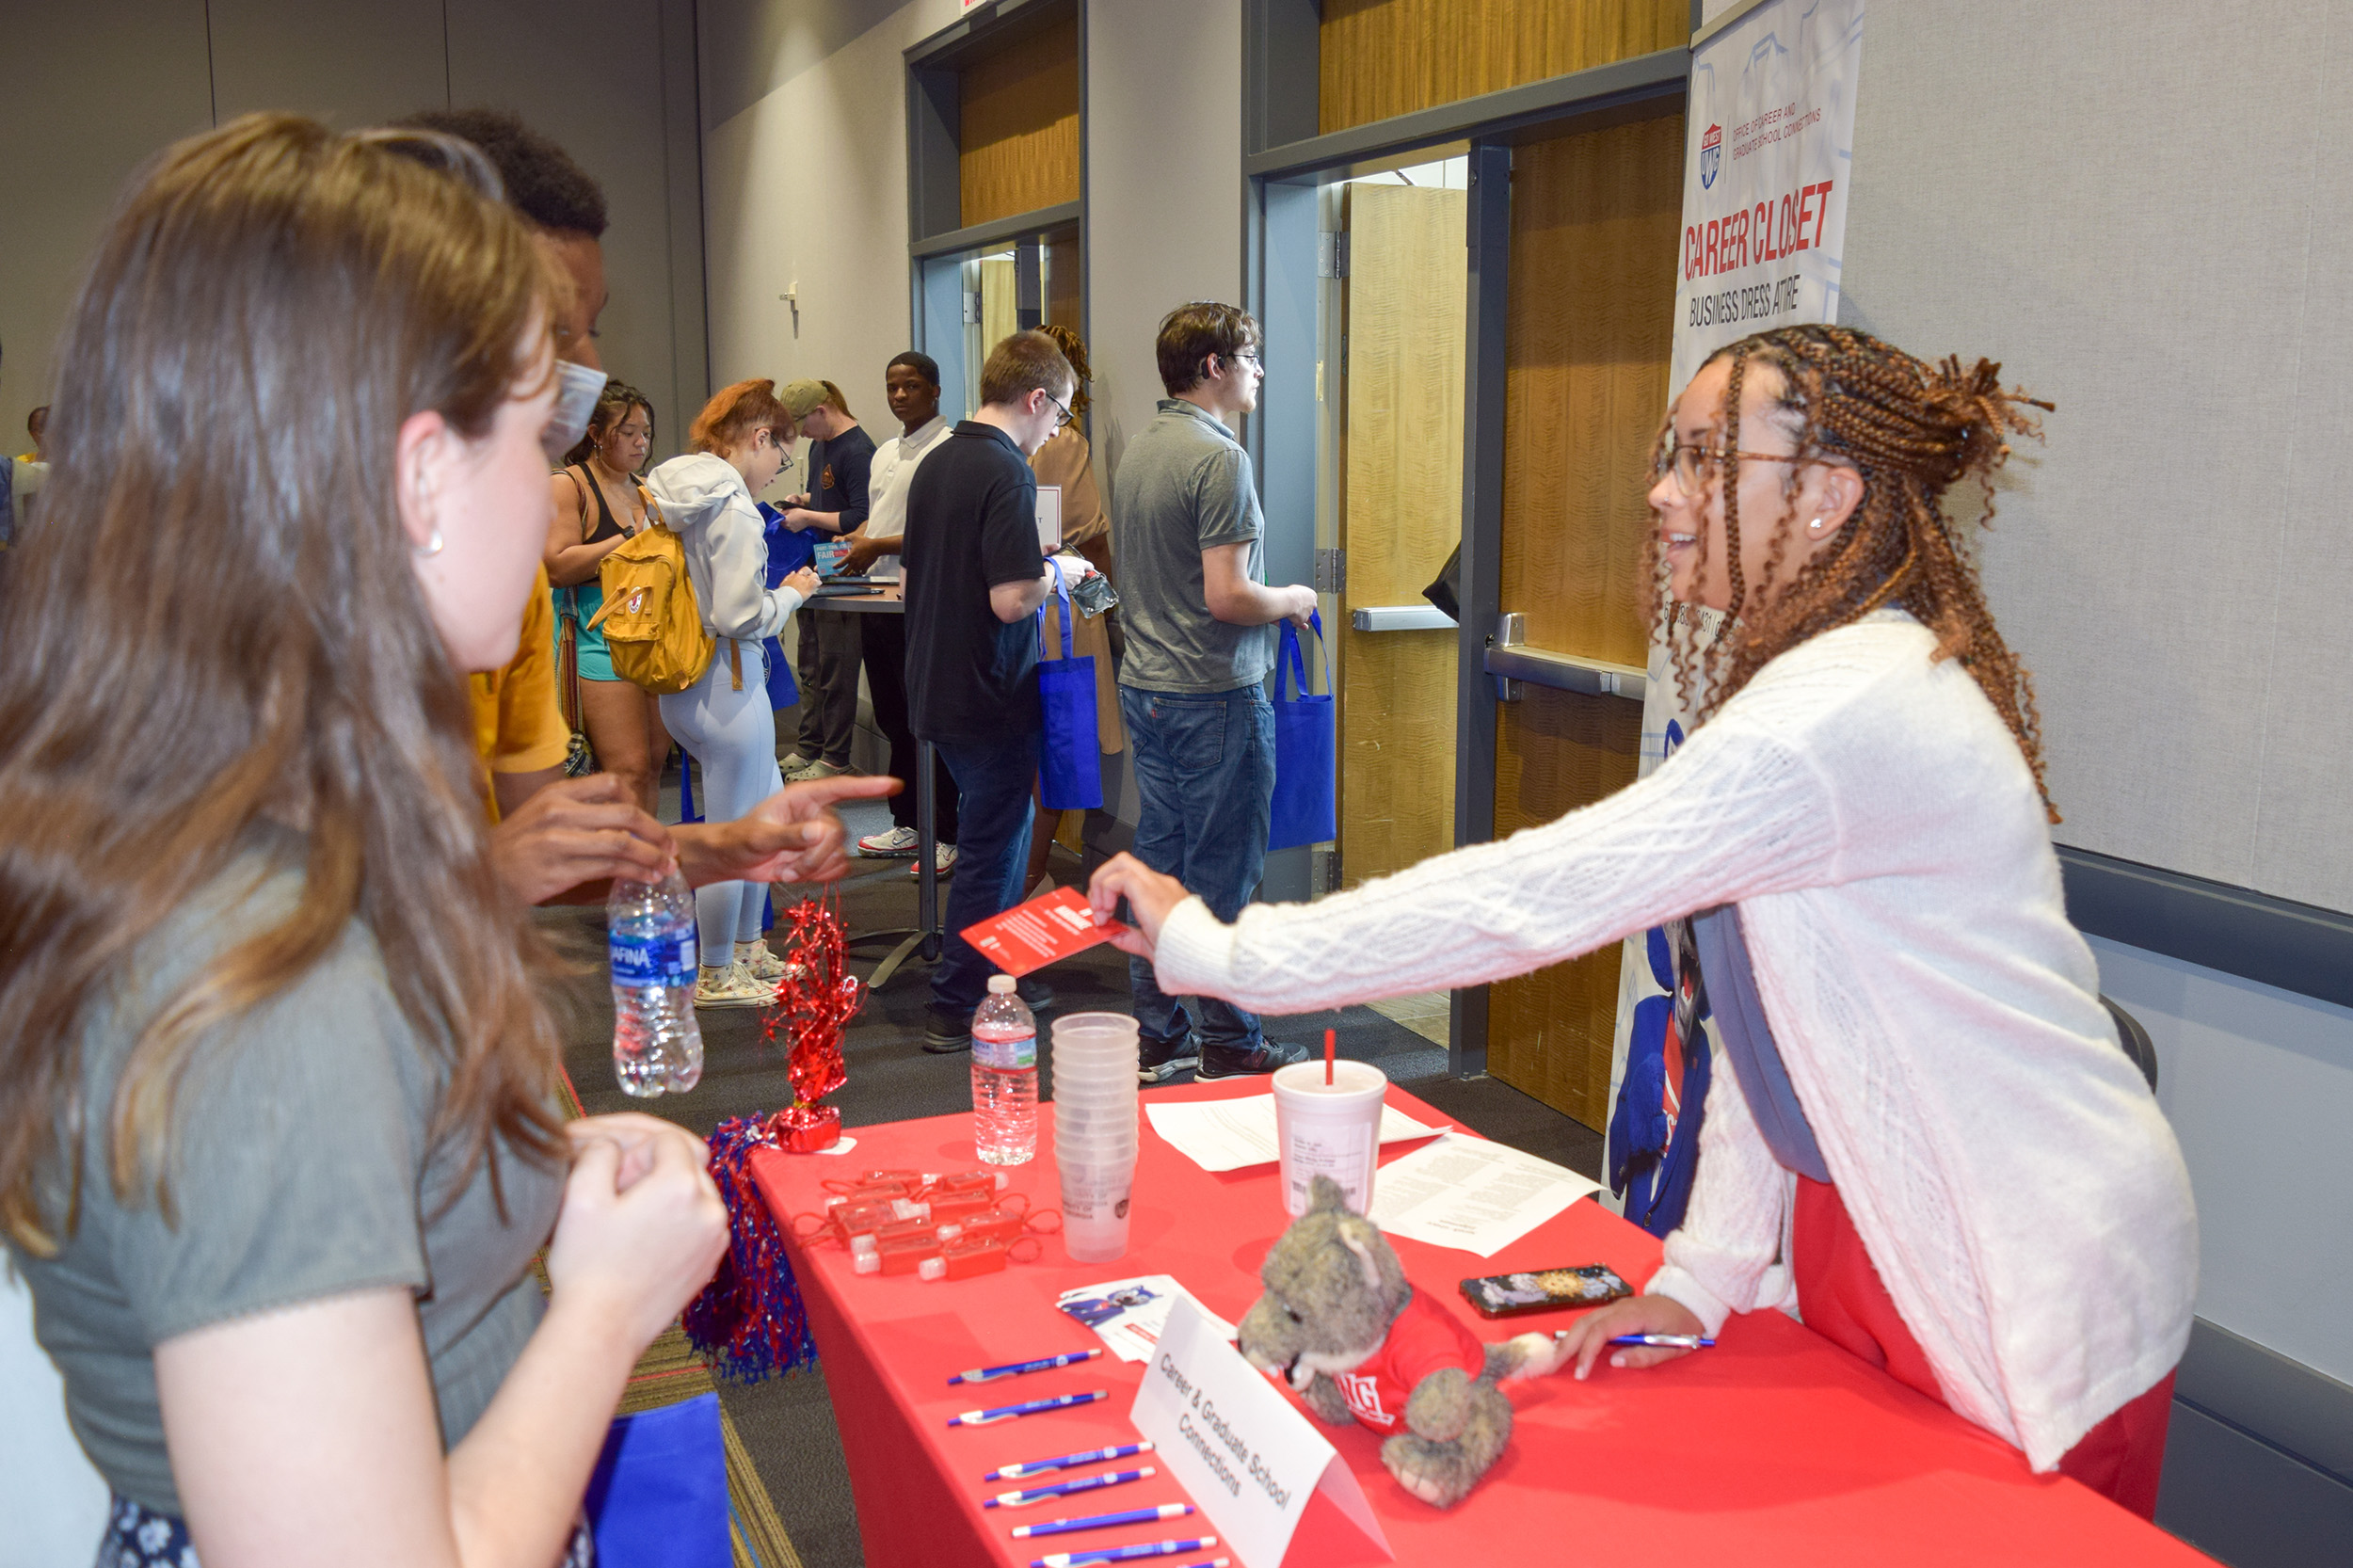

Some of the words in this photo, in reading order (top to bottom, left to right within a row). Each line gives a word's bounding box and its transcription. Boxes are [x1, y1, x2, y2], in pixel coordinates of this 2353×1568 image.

[1733, 122, 1750, 142] OFFICE
[1751, 119, 1759, 134] OF
[1758, 108, 1783, 129] CAREER
[1783, 102, 1796, 119] AND
[1733, 137, 1758, 160] GRADUATE
[1758, 128, 1782, 149] SCHOOL
[1701, 147, 1721, 186] UWG
[1685, 209, 1750, 281] CAREER
[1753, 180, 1833, 264] CLOSET
[1689, 290, 1739, 327] BUSINESS
[1741, 282, 1771, 321] DRESS
[817, 550, 835, 560] FAIR
[1160, 1352, 1192, 1398] Career
[1192, 1388, 1202, 1409] &
[1202, 1400, 1248, 1463] Graduate
[1248, 1453, 1291, 1510] School
[1179, 1413, 1241, 1497] Connections
